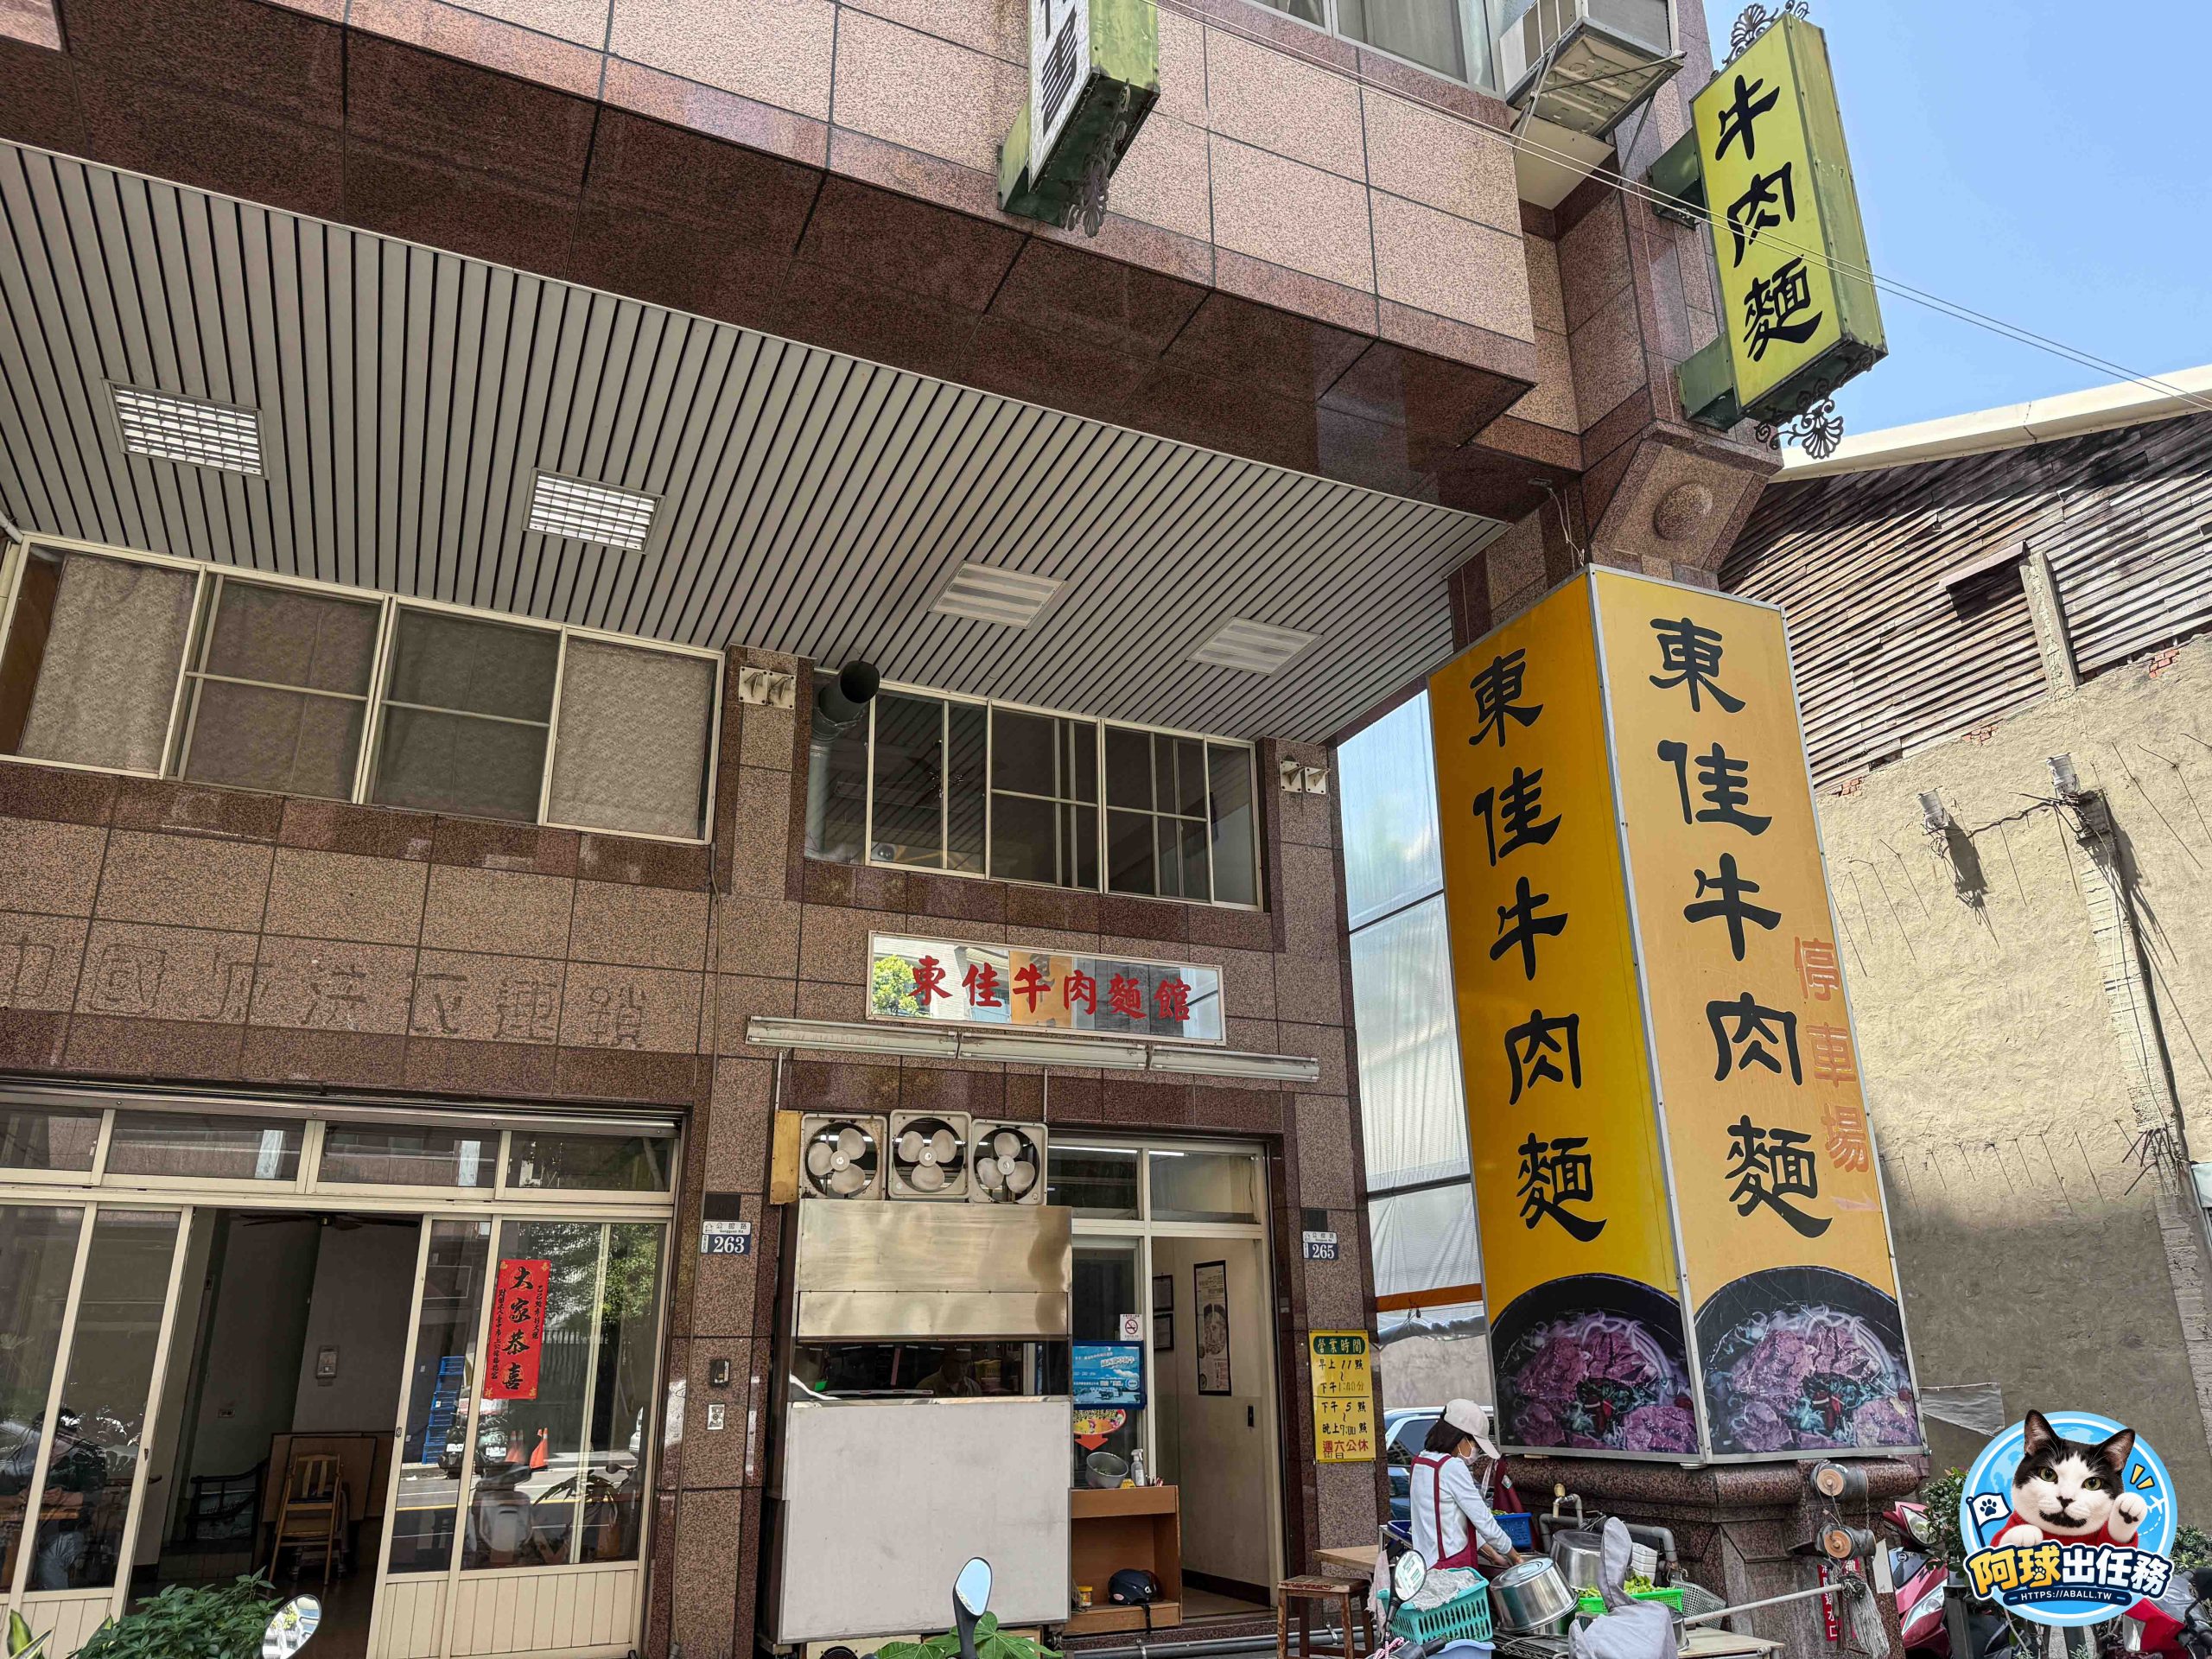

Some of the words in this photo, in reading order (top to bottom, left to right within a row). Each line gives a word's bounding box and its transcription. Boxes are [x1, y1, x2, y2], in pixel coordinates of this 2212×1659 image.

[1715, 74, 1822, 362] 牛肉麵
[1468, 647, 1607, 1243] 東佳牛肉麵
[1649, 617, 1833, 1238] 東佳牛肉麵
[907, 955, 1192, 1022] 東佳牛肉麵館
[1795, 937, 1869, 1173] 停車場
[713, 1236, 745, 1254] 263
[1312, 1244, 1335, 1259] 265
[502, 1267, 533, 1390] 大家恭喜
[1317, 1338, 1362, 1354] 營業時間
[1323, 1439, 1369, 1453] 週六公休
